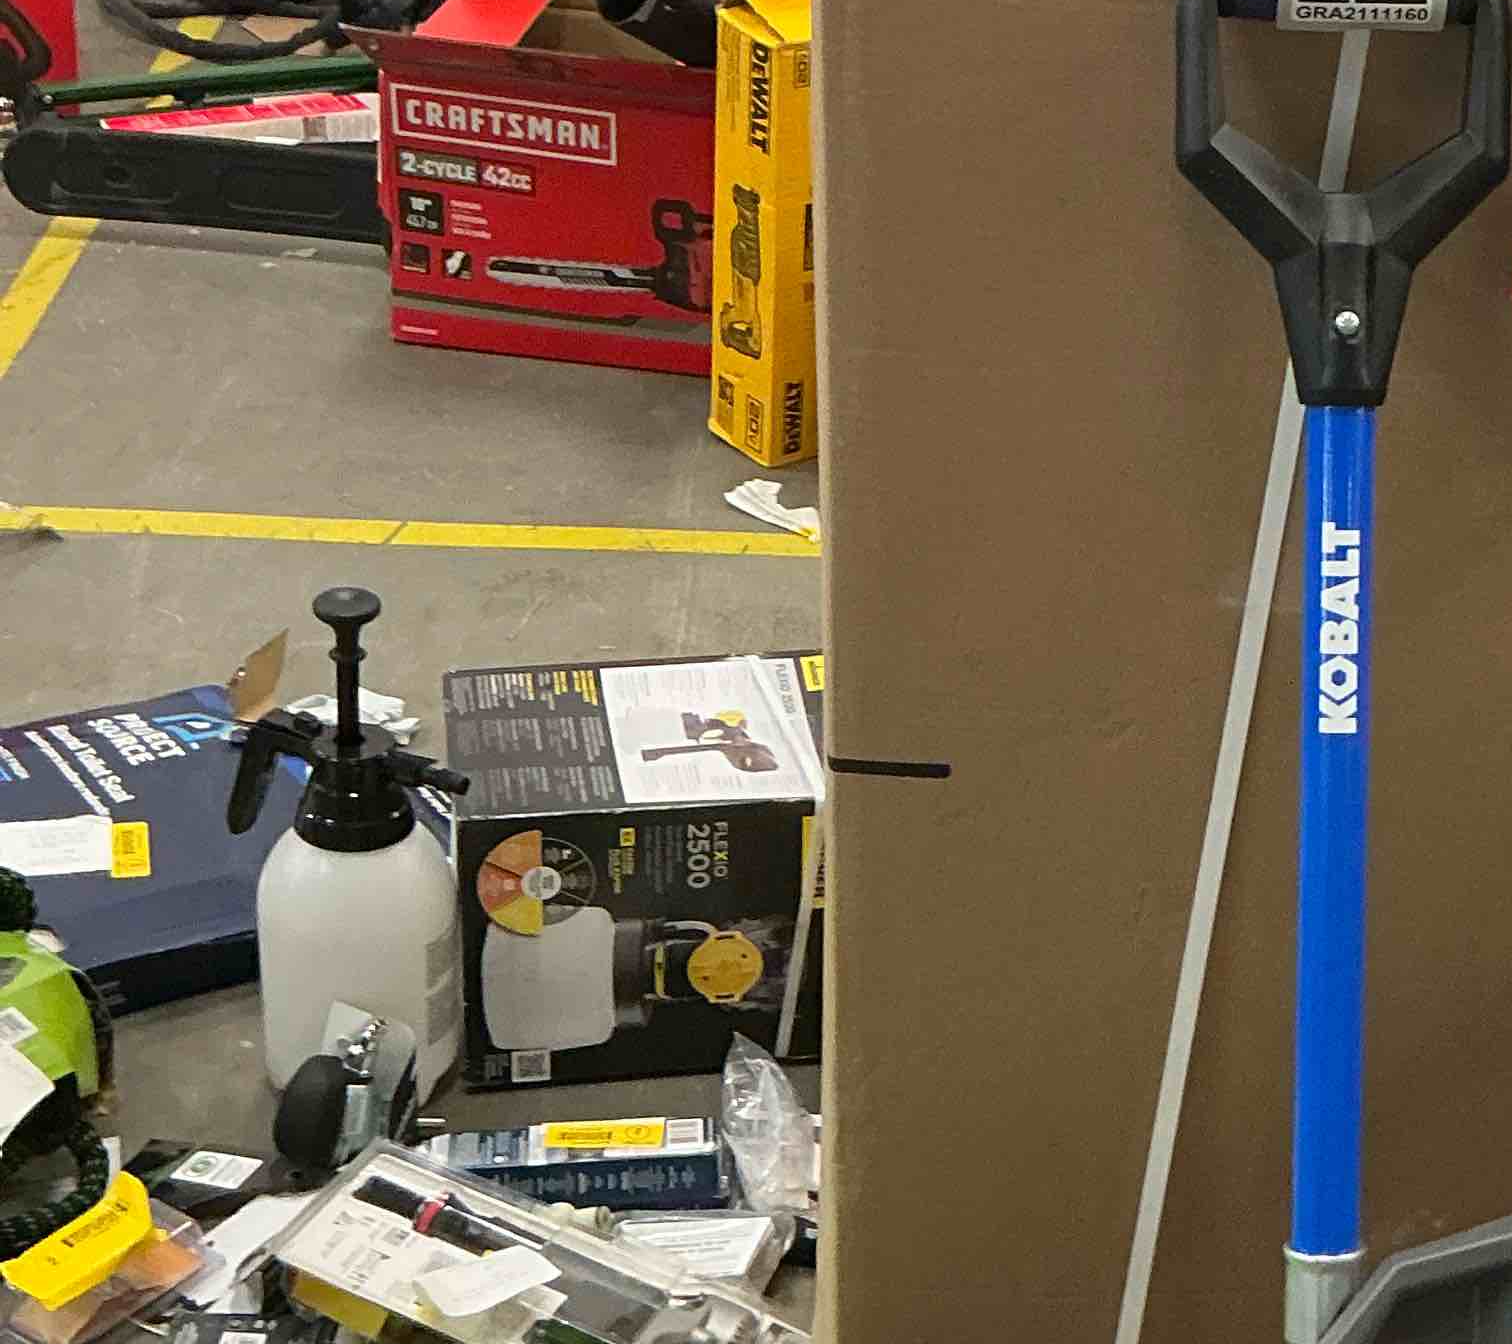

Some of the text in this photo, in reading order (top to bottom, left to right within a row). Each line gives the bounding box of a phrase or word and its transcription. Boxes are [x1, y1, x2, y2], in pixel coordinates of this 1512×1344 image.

[1296, 6, 1429, 21] GRA2111160
[405, 99, 601, 150] CRAFTSMAN
[401, 151, 478, 183] 2-CYCLE
[1318, 522, 1361, 735] KOBALT
[686, 823, 711, 889] 2500
[712, 820, 729, 879] FLEXIO
